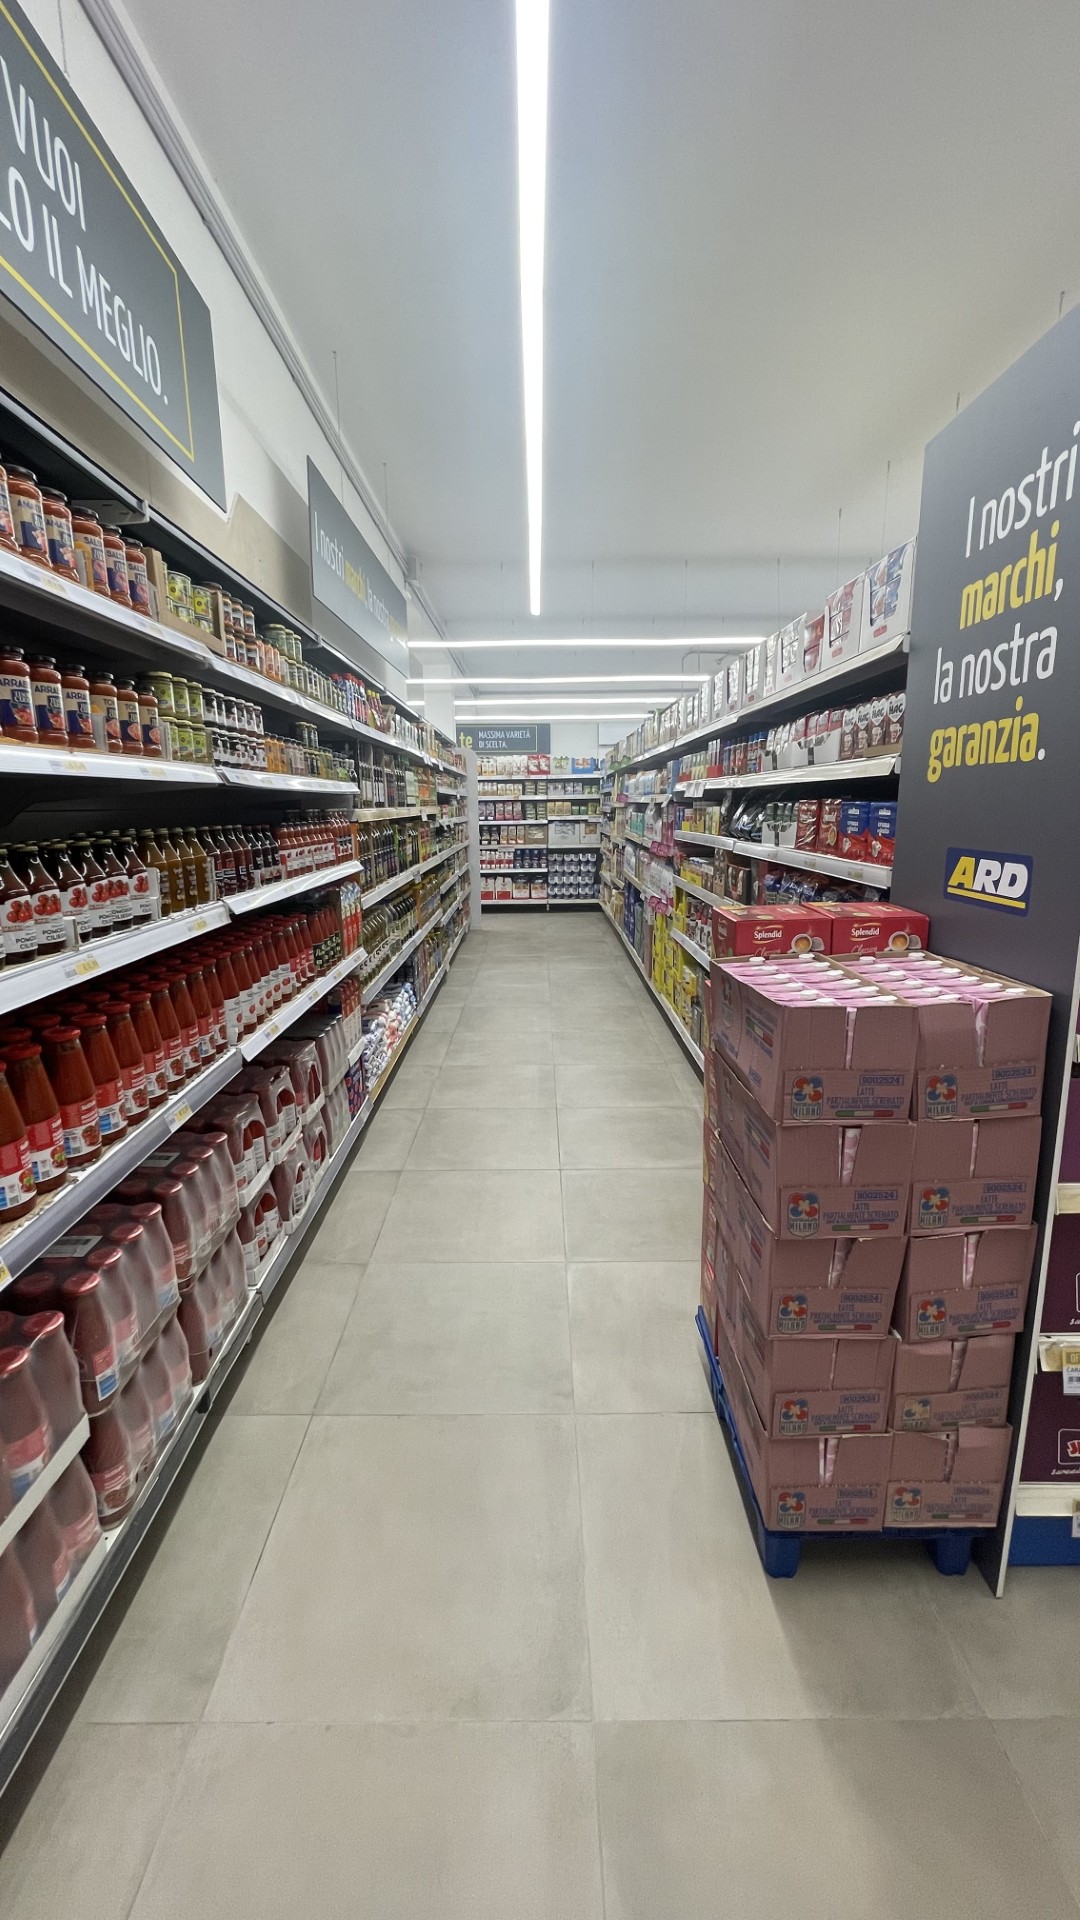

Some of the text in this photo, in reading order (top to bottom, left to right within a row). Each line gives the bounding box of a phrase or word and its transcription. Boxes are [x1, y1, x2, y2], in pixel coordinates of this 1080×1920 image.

[0, 55, 86, 232] VUOI
[0, 166, 169, 405] O IL MEGLIO.
[964, 420, 1080, 558] I nostri
[320, 528, 345, 582] nostri
[959, 519, 1064, 630] marchi,
[933, 622, 1058, 705] la nostra
[888, 701, 904, 715] HAG
[478, 730, 505, 739] MASSIMA
[927, 695, 1046, 783] garanzia.
[947, 856, 1030, 899] ARD
[754, 929, 783, 940] Splendid
[851, 927, 880, 938] Splendid
[862, 1076, 900, 1085] 9002524
[990, 1081, 1008, 1091] LATTE
[857, 1087, 875, 1096] LATTE
[793, 1106, 821, 1116] MILANO
[927, 1105, 956, 1115] MILANO
[857, 1191, 895, 1200] 9002524
[981, 1195, 999, 1204] LATTE
[852, 1203, 870, 1211] LATTE
[920, 1214, 947, 1224] MILANO
[789, 1222, 818, 1232] MILANO
[838, 1304, 855, 1312] LATTE
[778, 1321, 806, 1330] MILANO
